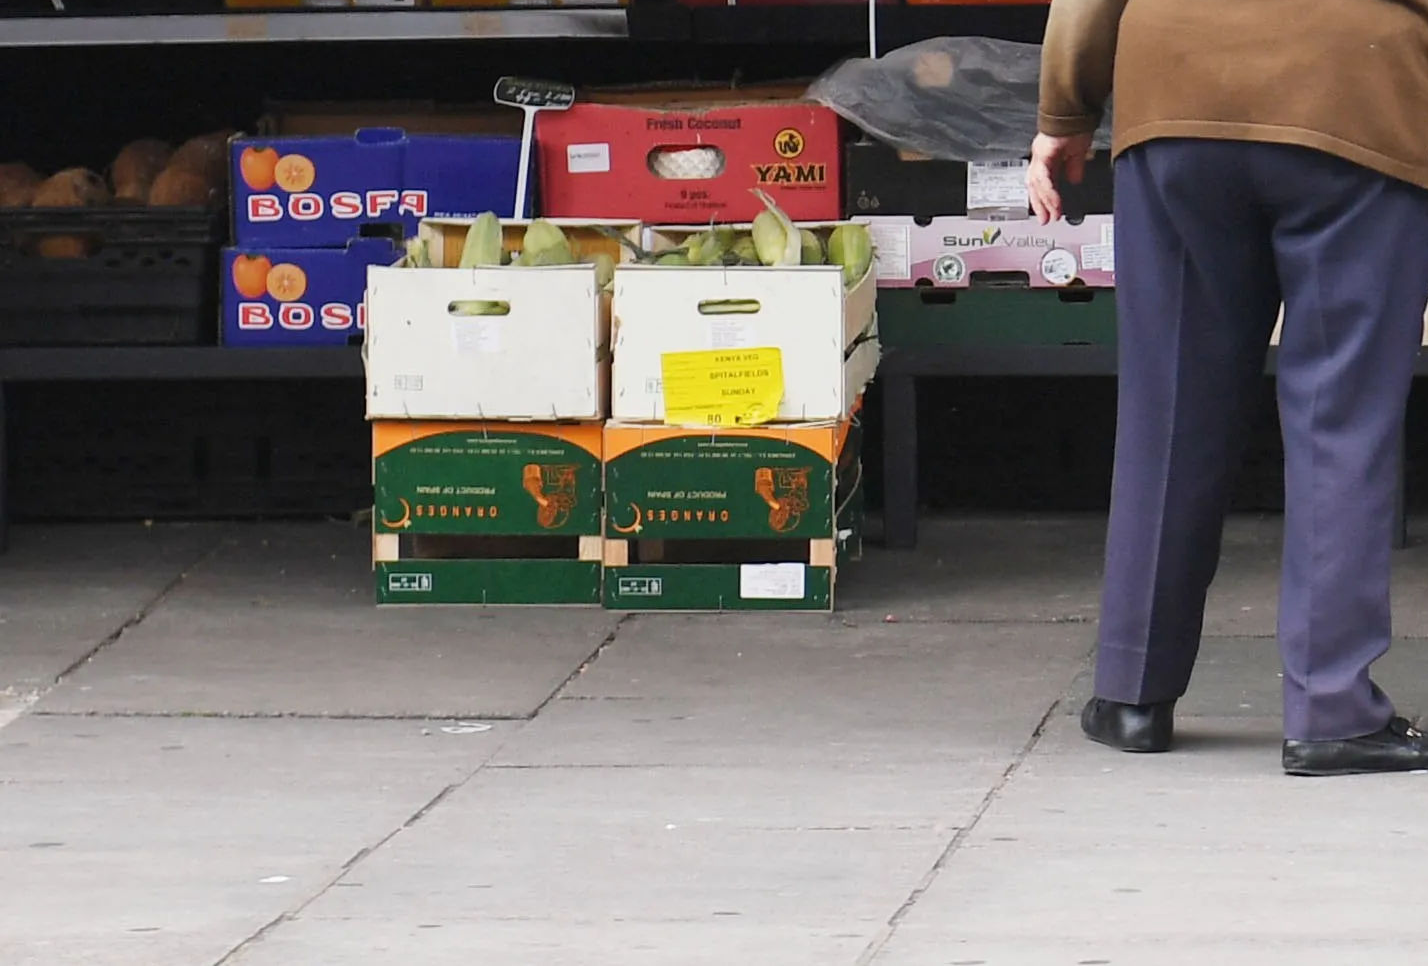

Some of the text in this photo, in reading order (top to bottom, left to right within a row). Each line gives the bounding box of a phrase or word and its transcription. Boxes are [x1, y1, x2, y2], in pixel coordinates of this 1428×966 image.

[647, 118, 742, 130] Fresh Coconut
[753, 164, 826, 183] YAMI
[248, 190, 428, 222] BOSFA
[943, 236, 1056, 248] Sun Valley
[709, 368, 770, 380] SPITALFIELDS
[721, 386, 757, 397] SUNDAY
[416, 486, 496, 496] PRODUCT OF SPAIN
[647, 490, 727, 499] PRODUCT OF SPAIN
[415, 504, 498, 518] ORANGES
[646, 509, 729, 522] ORANGES
